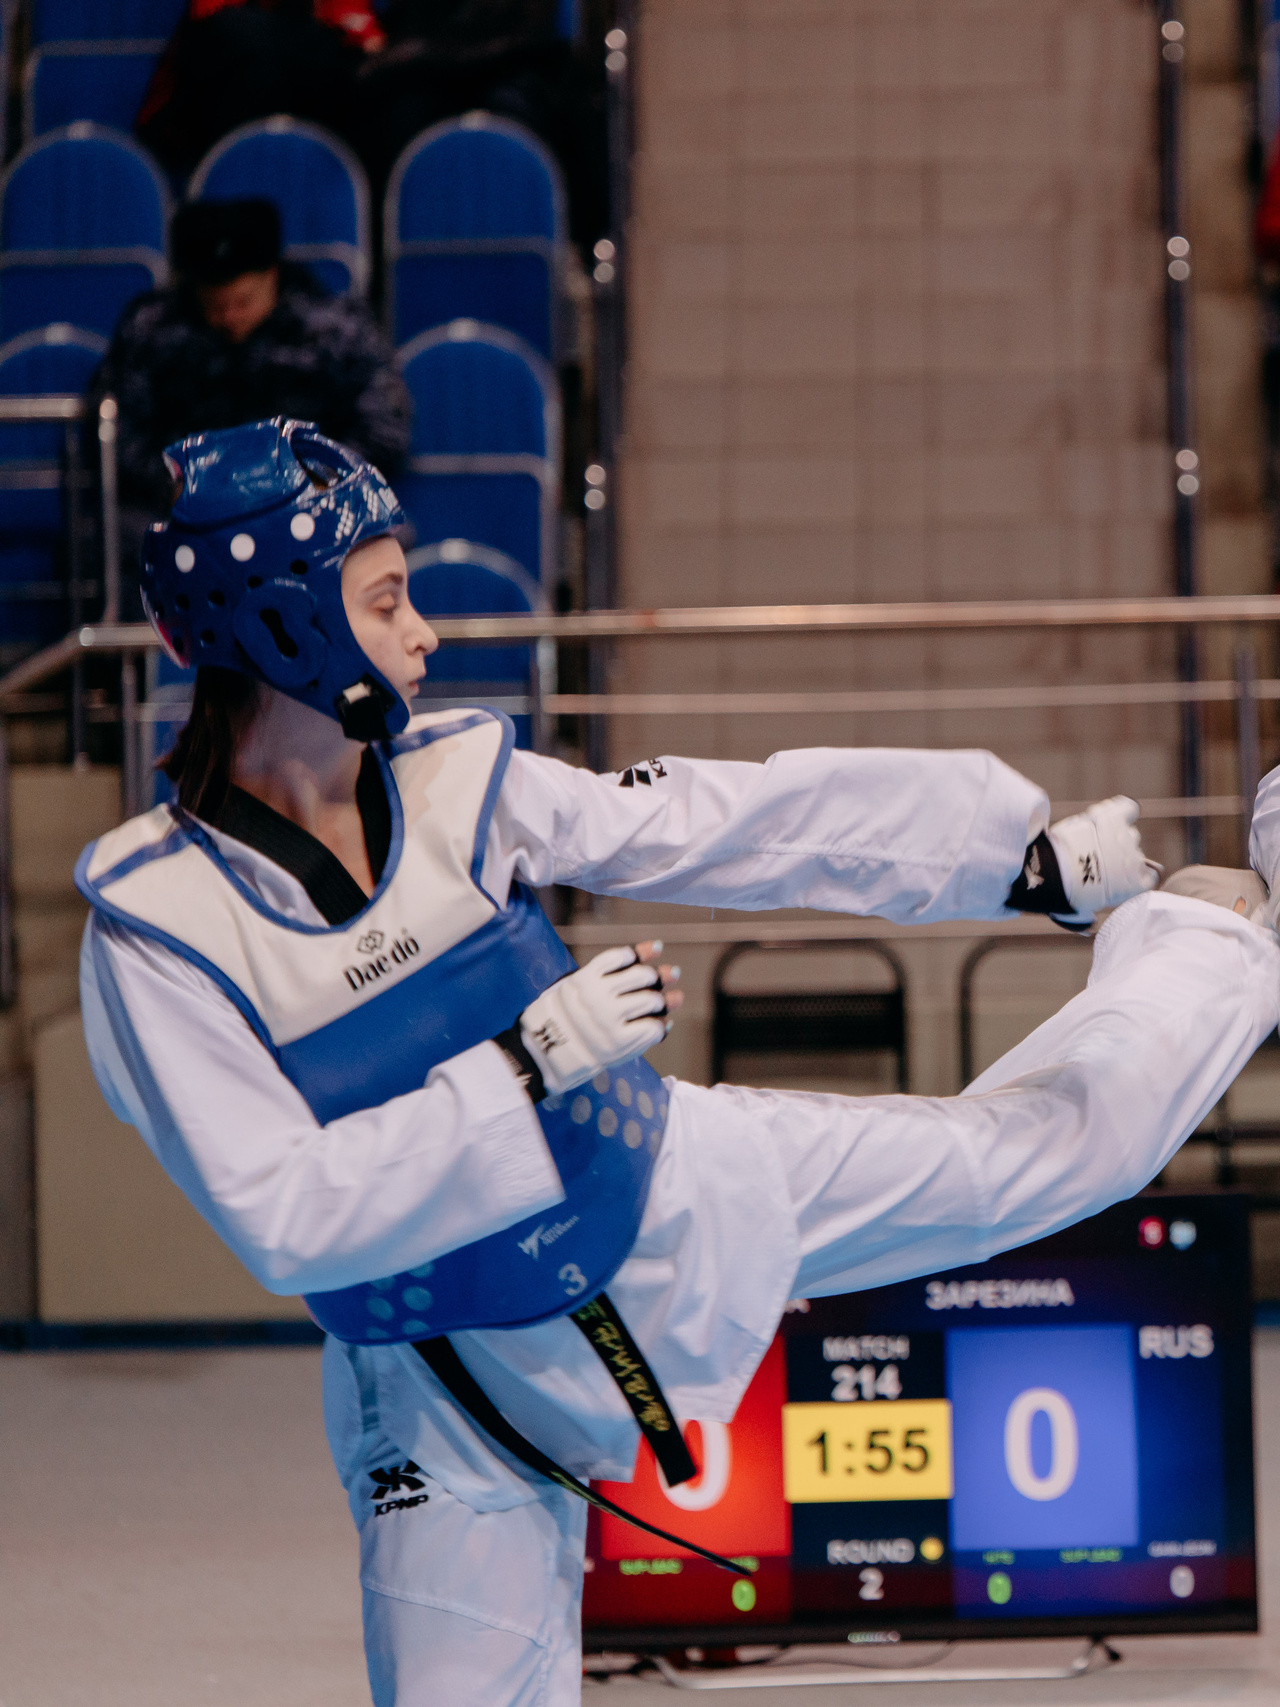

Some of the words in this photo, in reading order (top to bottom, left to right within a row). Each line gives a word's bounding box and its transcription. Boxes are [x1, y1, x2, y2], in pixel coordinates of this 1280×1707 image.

[557, 1262, 588, 1296] 3
[822, 1335, 910, 1361] MATCH
[1139, 1324, 1214, 1359] RUS
[830, 1364, 903, 1401] 214
[809, 1427, 931, 1475] 1:55
[1004, 1387, 1079, 1500] 0
[827, 1537, 915, 1565] ROUND
[858, 1567, 885, 1600] 2
